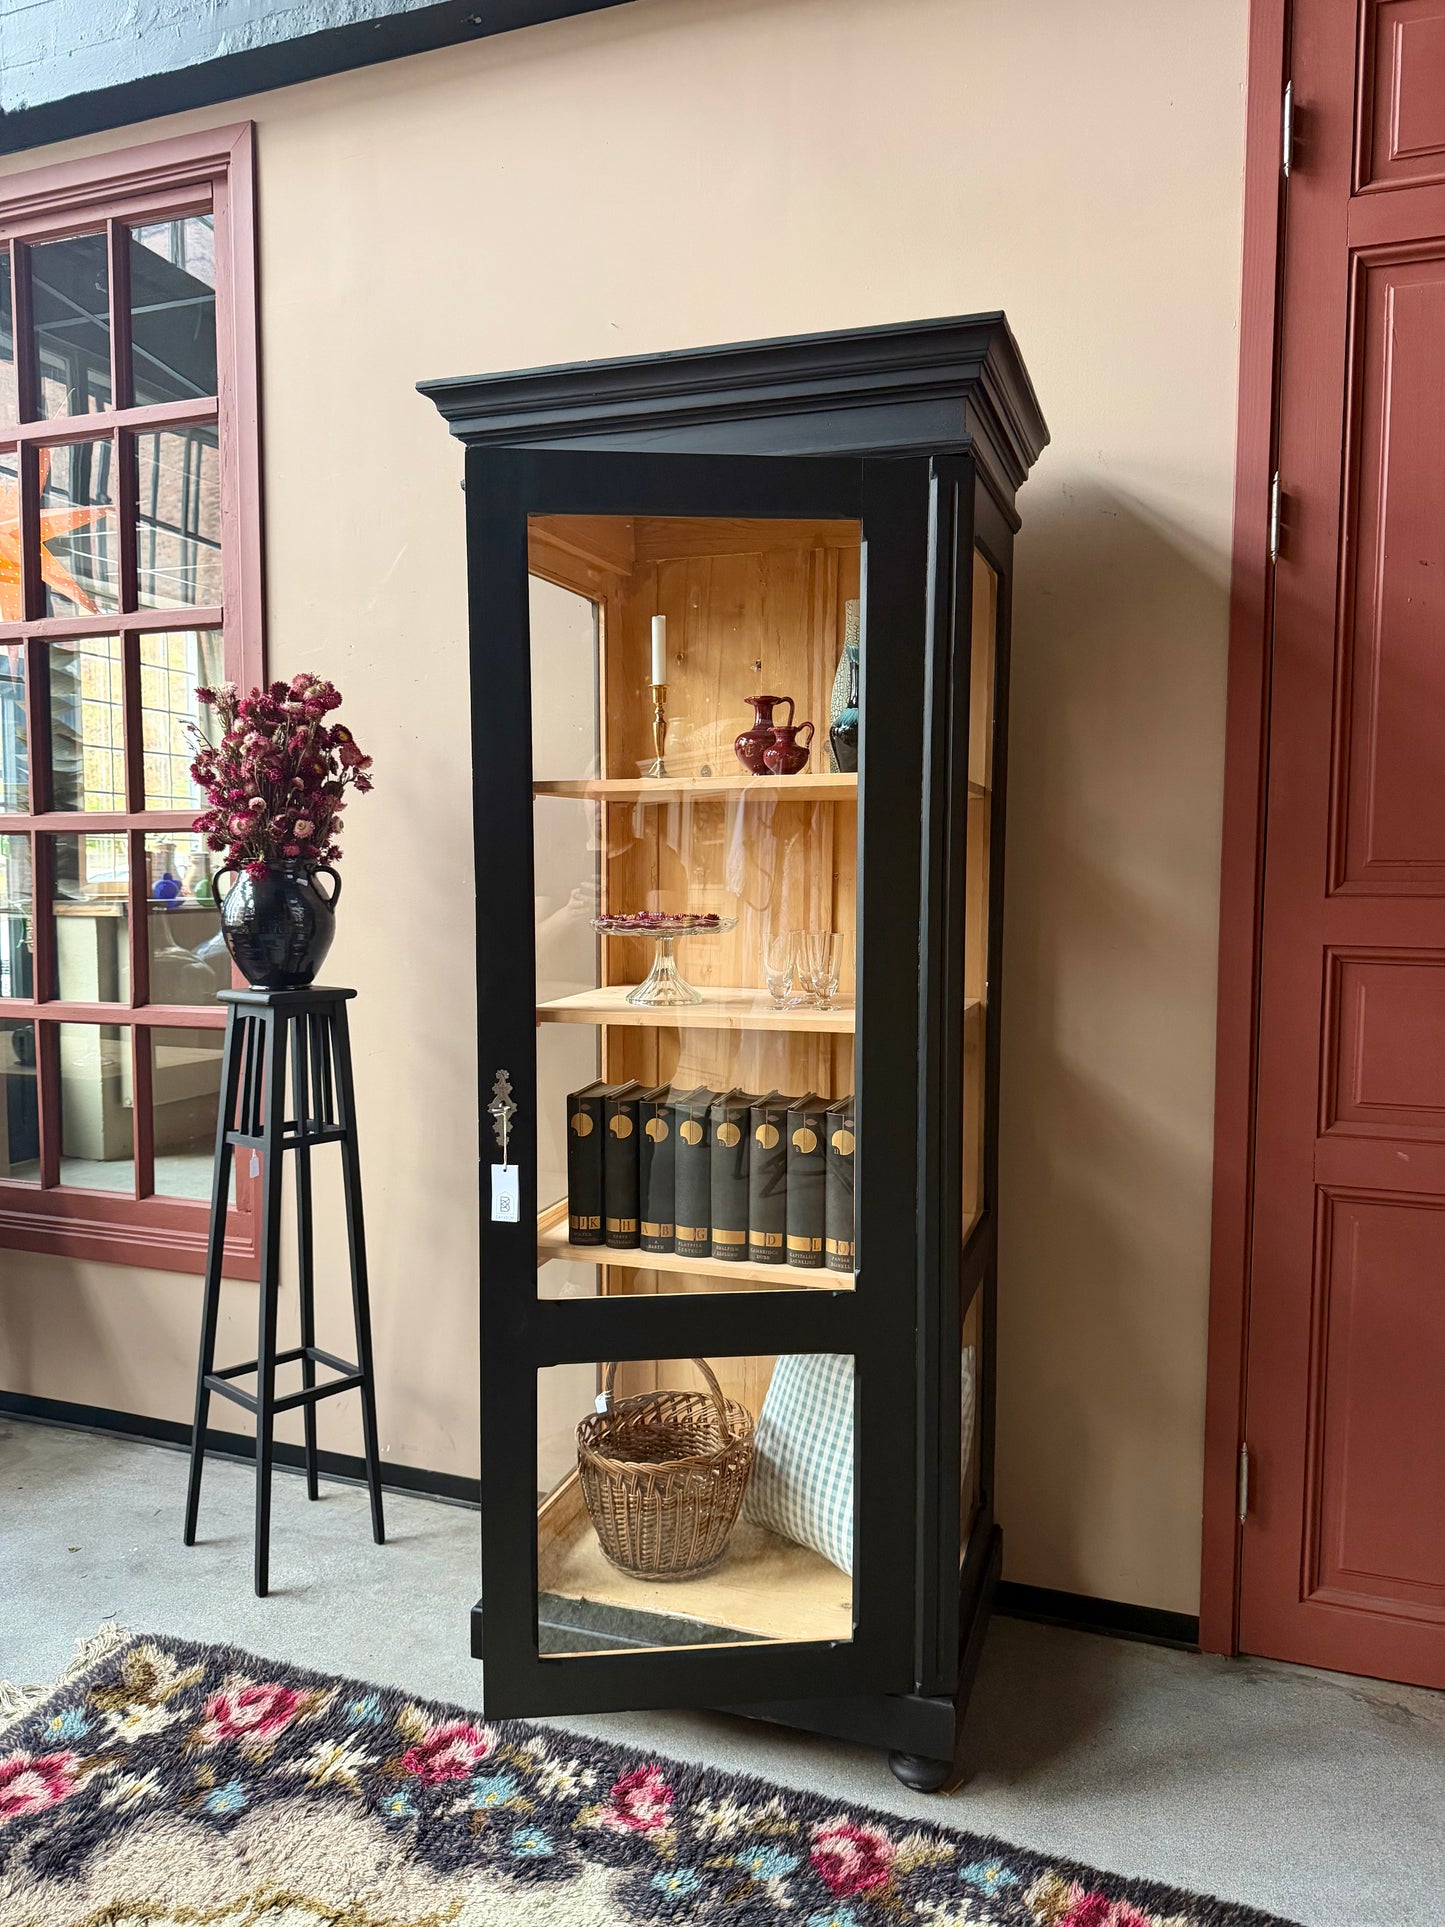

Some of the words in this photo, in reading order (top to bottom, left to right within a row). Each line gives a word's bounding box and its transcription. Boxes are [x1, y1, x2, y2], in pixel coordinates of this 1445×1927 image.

[590, 1217, 598, 1228] K
[622, 1220, 631, 1231] H
[642, 1223, 649, 1234] A
[662, 1225, 670, 1236] B
[696, 1229, 705, 1240] G
[768, 1235, 777, 1246] D
[813, 1239, 820, 1251] L
